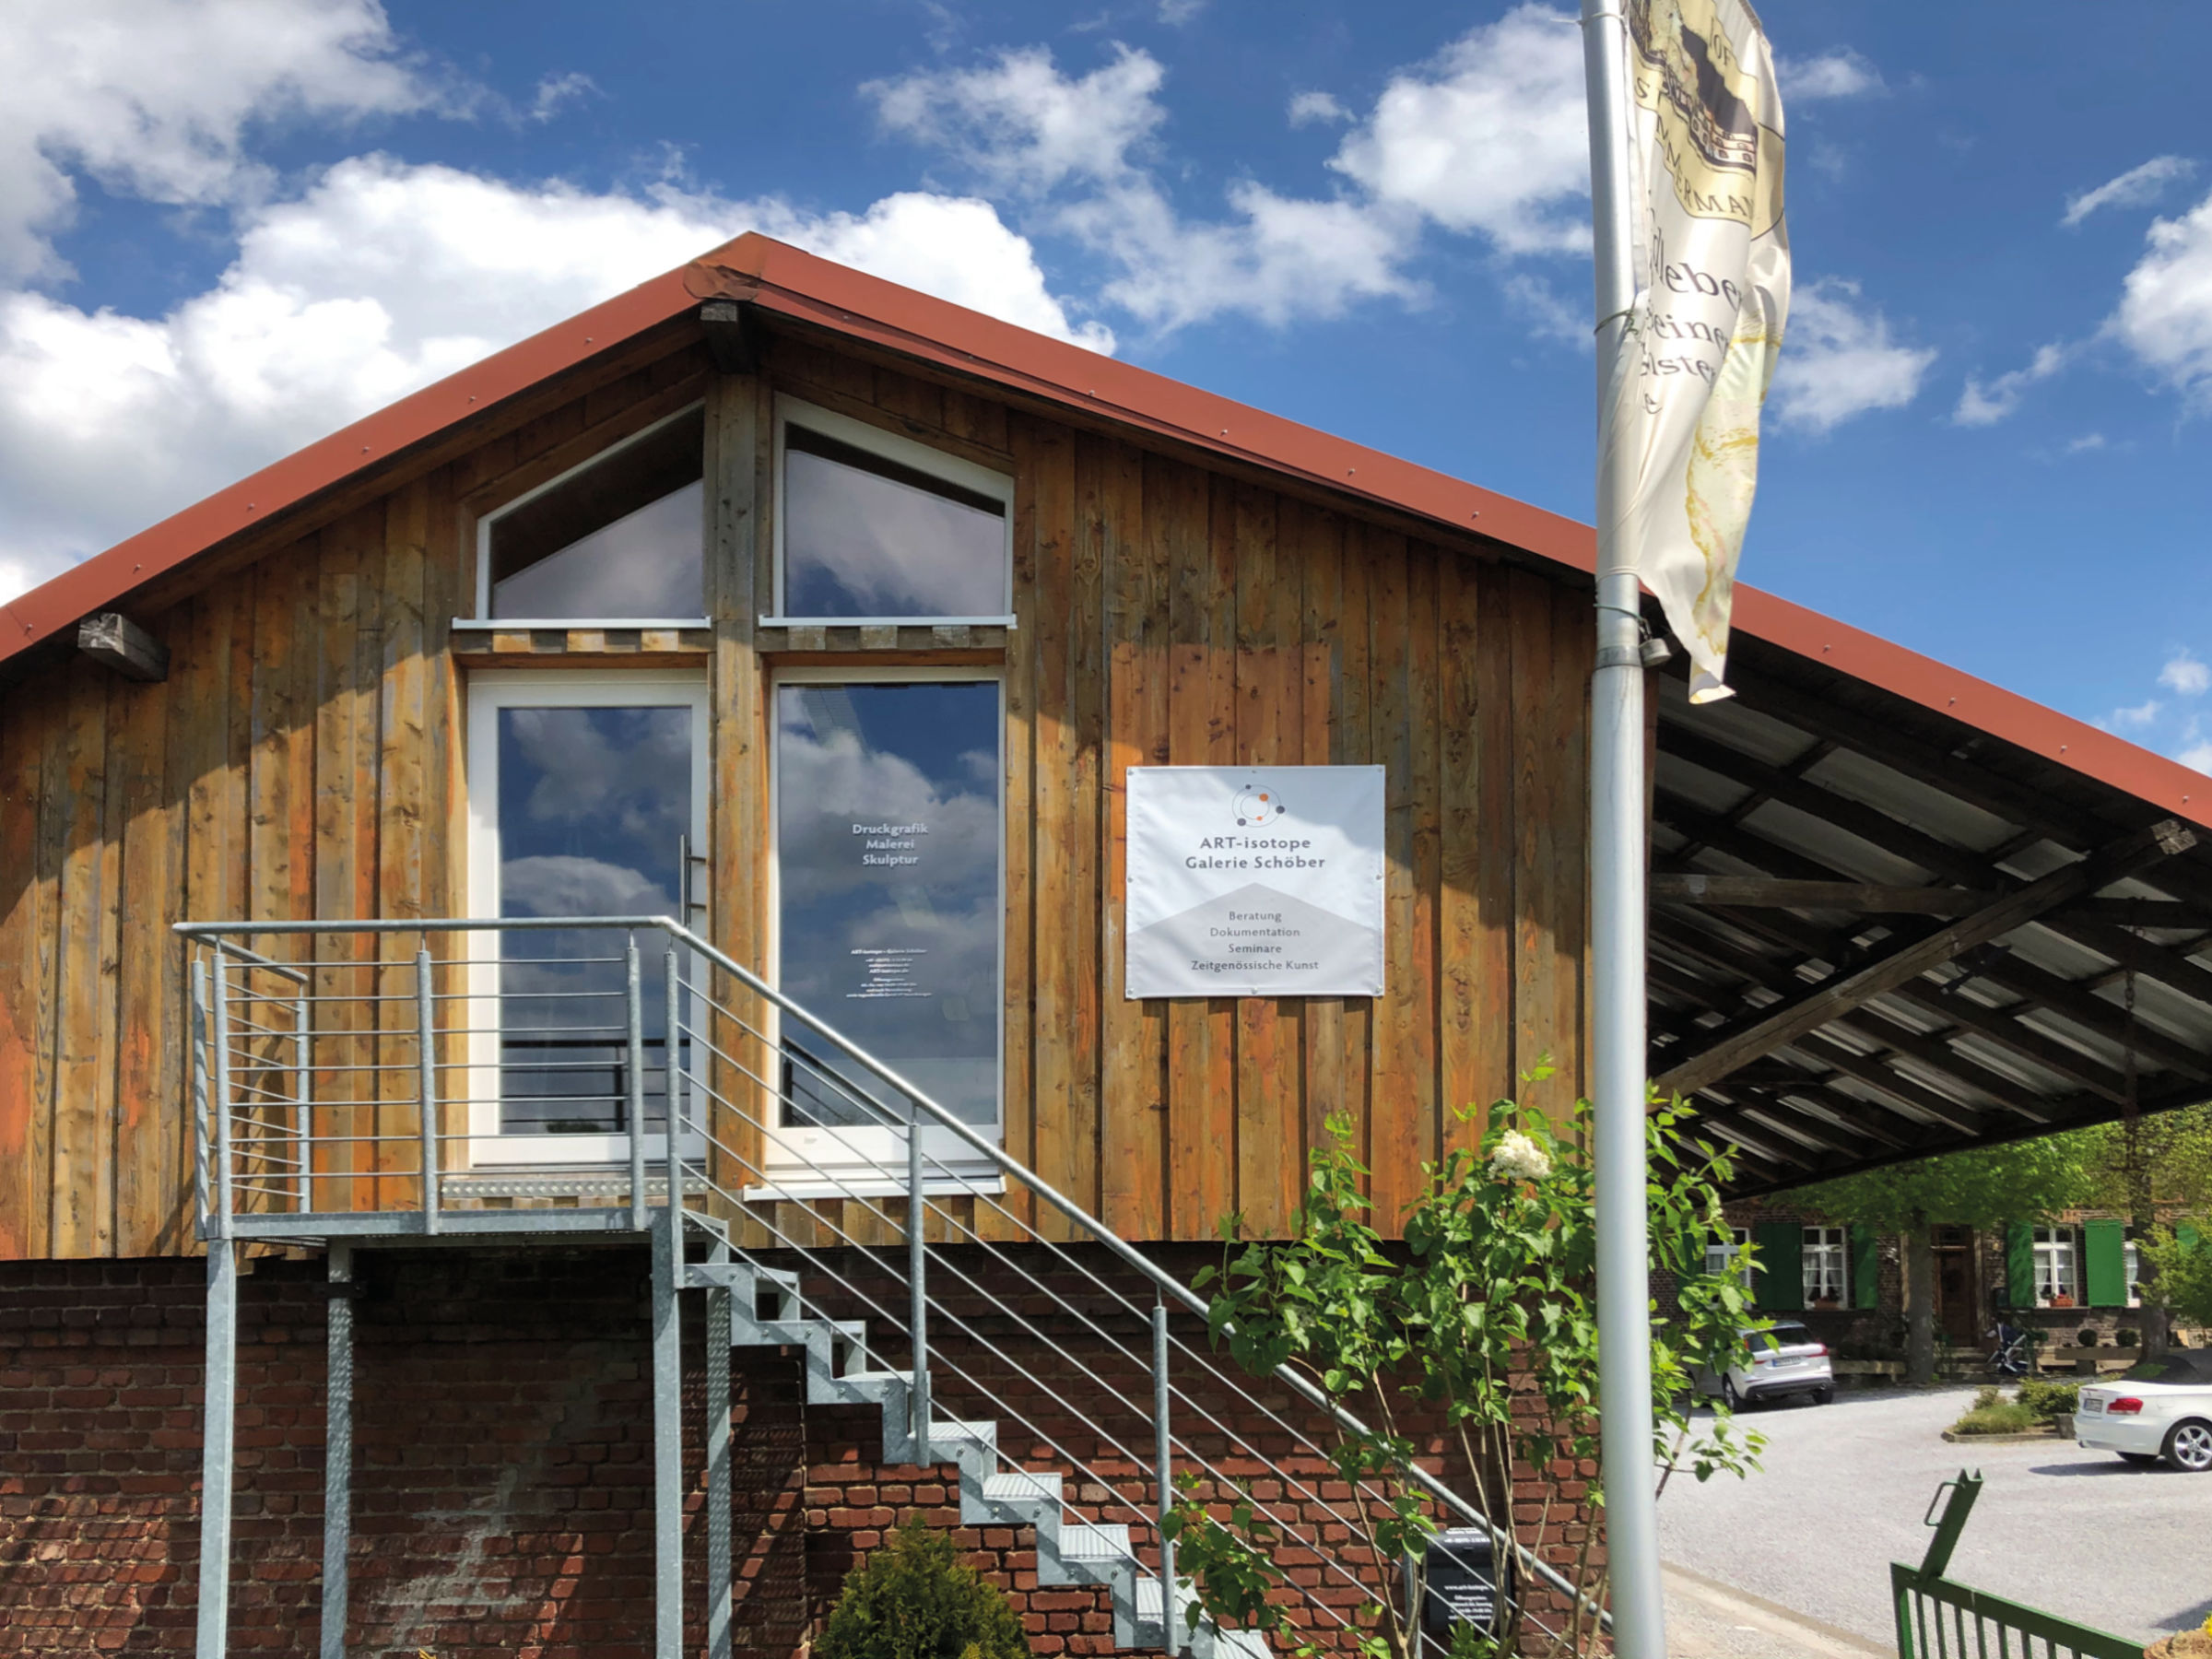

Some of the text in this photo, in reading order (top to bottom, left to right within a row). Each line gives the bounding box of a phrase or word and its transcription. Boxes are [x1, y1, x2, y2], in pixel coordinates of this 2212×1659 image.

[852, 823, 929, 838] Druckgrafik
[866, 839, 915, 850] Malerei
[1200, 837, 1312, 853] ART-isotope
[863, 853, 919, 867] Skulptur
[1185, 856, 1325, 869] Galerie Schöber
[1229, 911, 1282, 923] Beratung
[1210, 927, 1300, 937] Dokumentation
[1229, 944, 1282, 954] Seminare
[1191, 960, 1319, 973] Zeitgenössische Kunst
